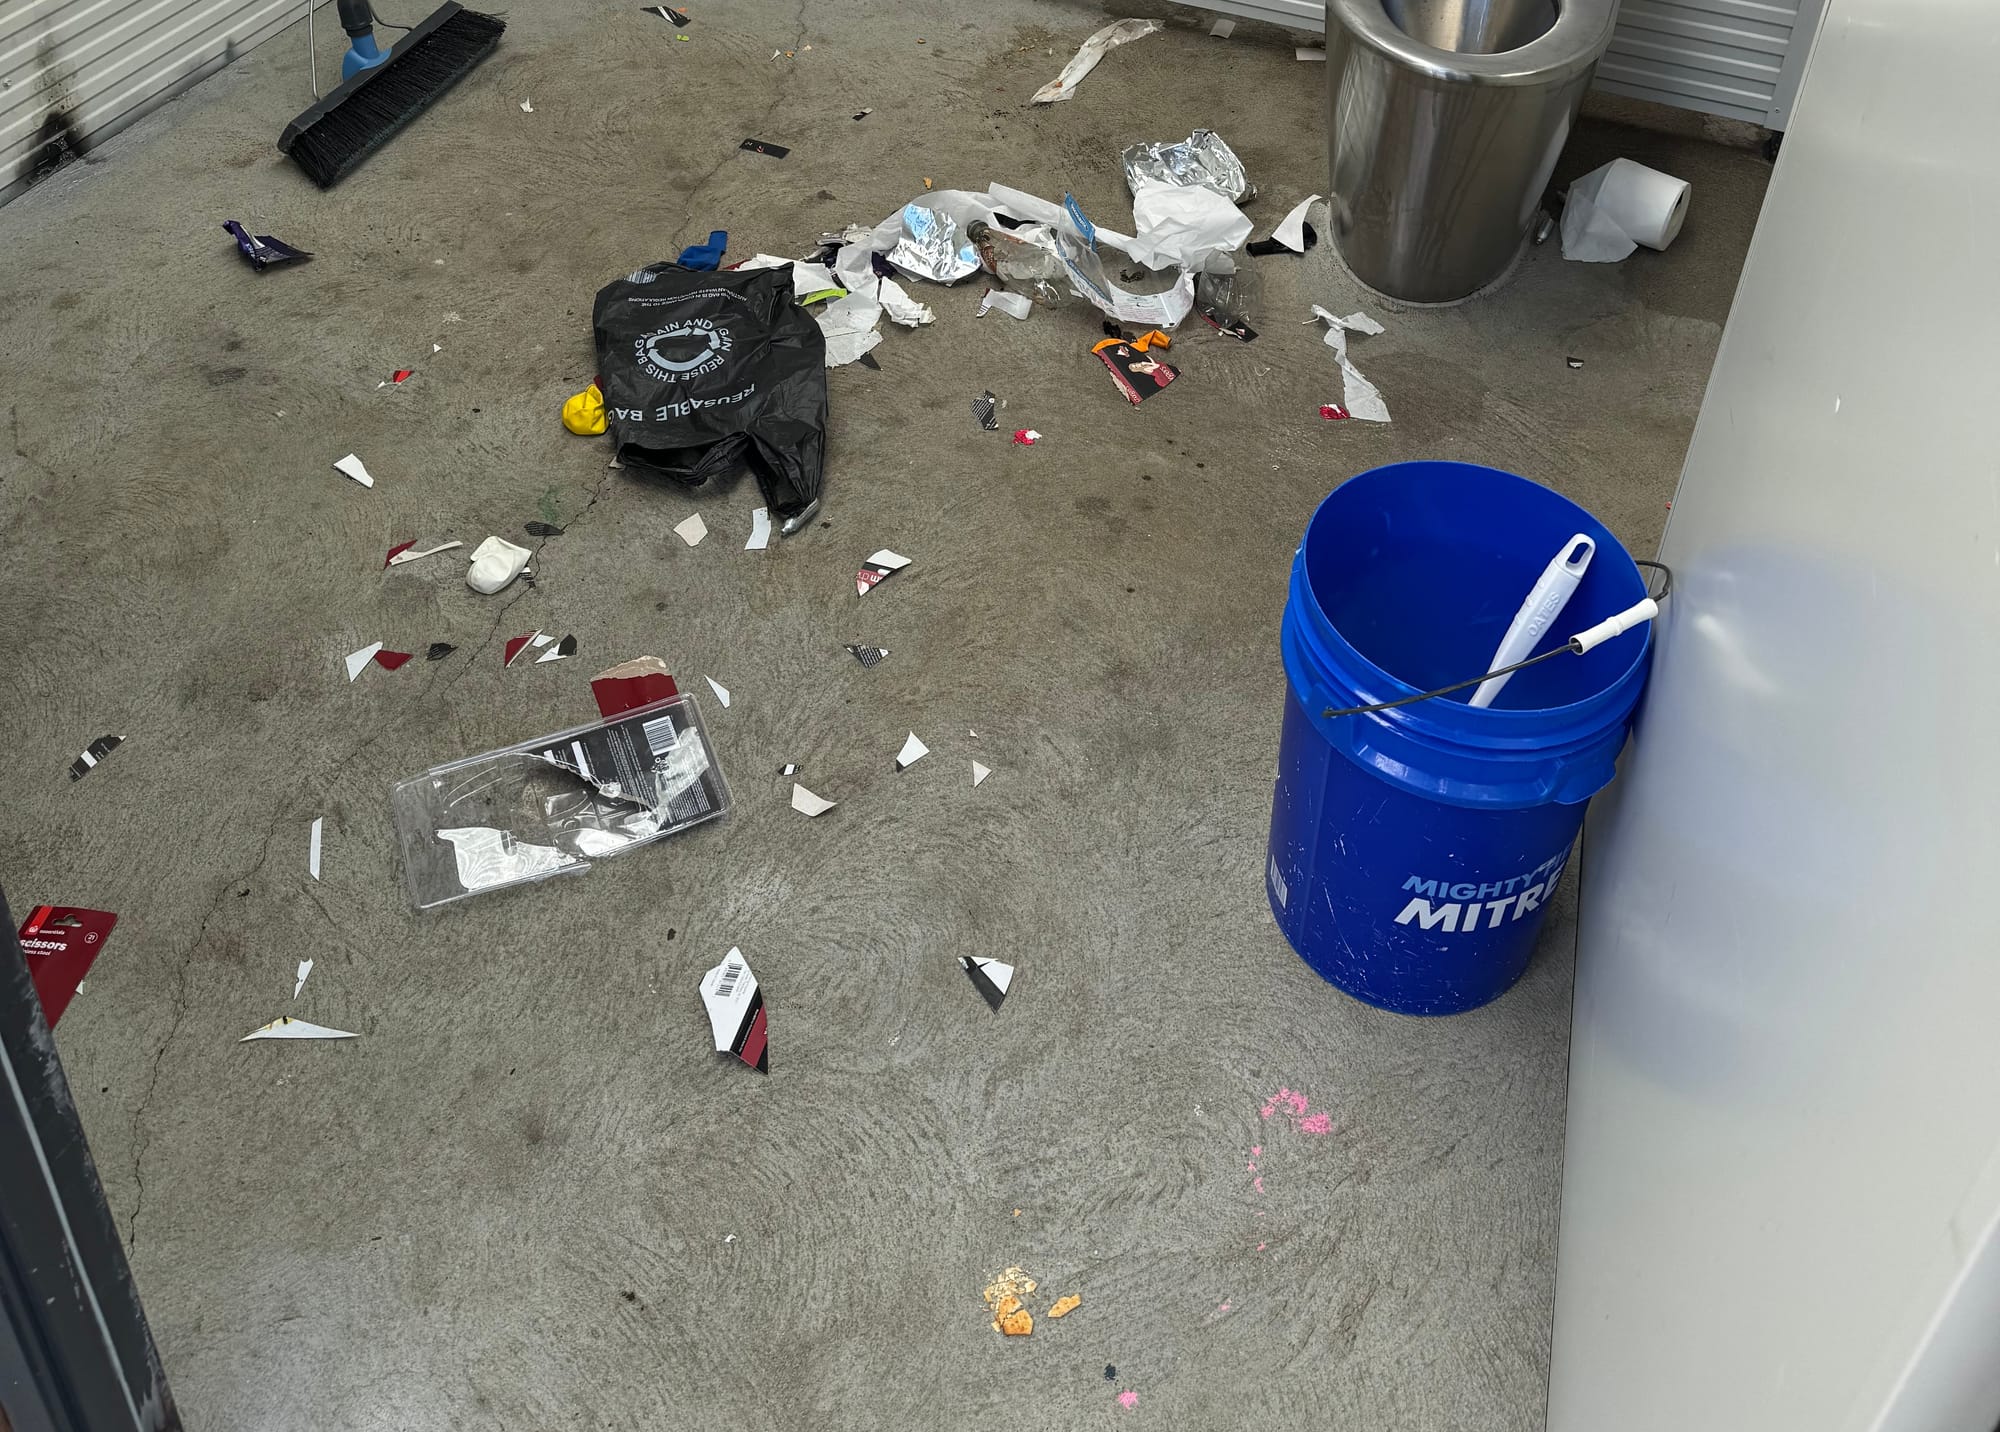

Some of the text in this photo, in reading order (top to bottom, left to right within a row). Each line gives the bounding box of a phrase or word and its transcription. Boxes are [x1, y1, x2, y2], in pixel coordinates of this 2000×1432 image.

[683, 318, 713, 330] AND
[634, 339, 648, 365] BAG
[718, 327, 733, 352] GAIN
[645, 363, 677, 383] THIS
[680, 354, 725, 381] REUSE
[607, 383, 755, 425] REUSABLE BAG
[1528, 591, 1560, 638] OATES
[1401, 870, 1537, 900] MIGHTY
[20, 938, 68, 951] scissors
